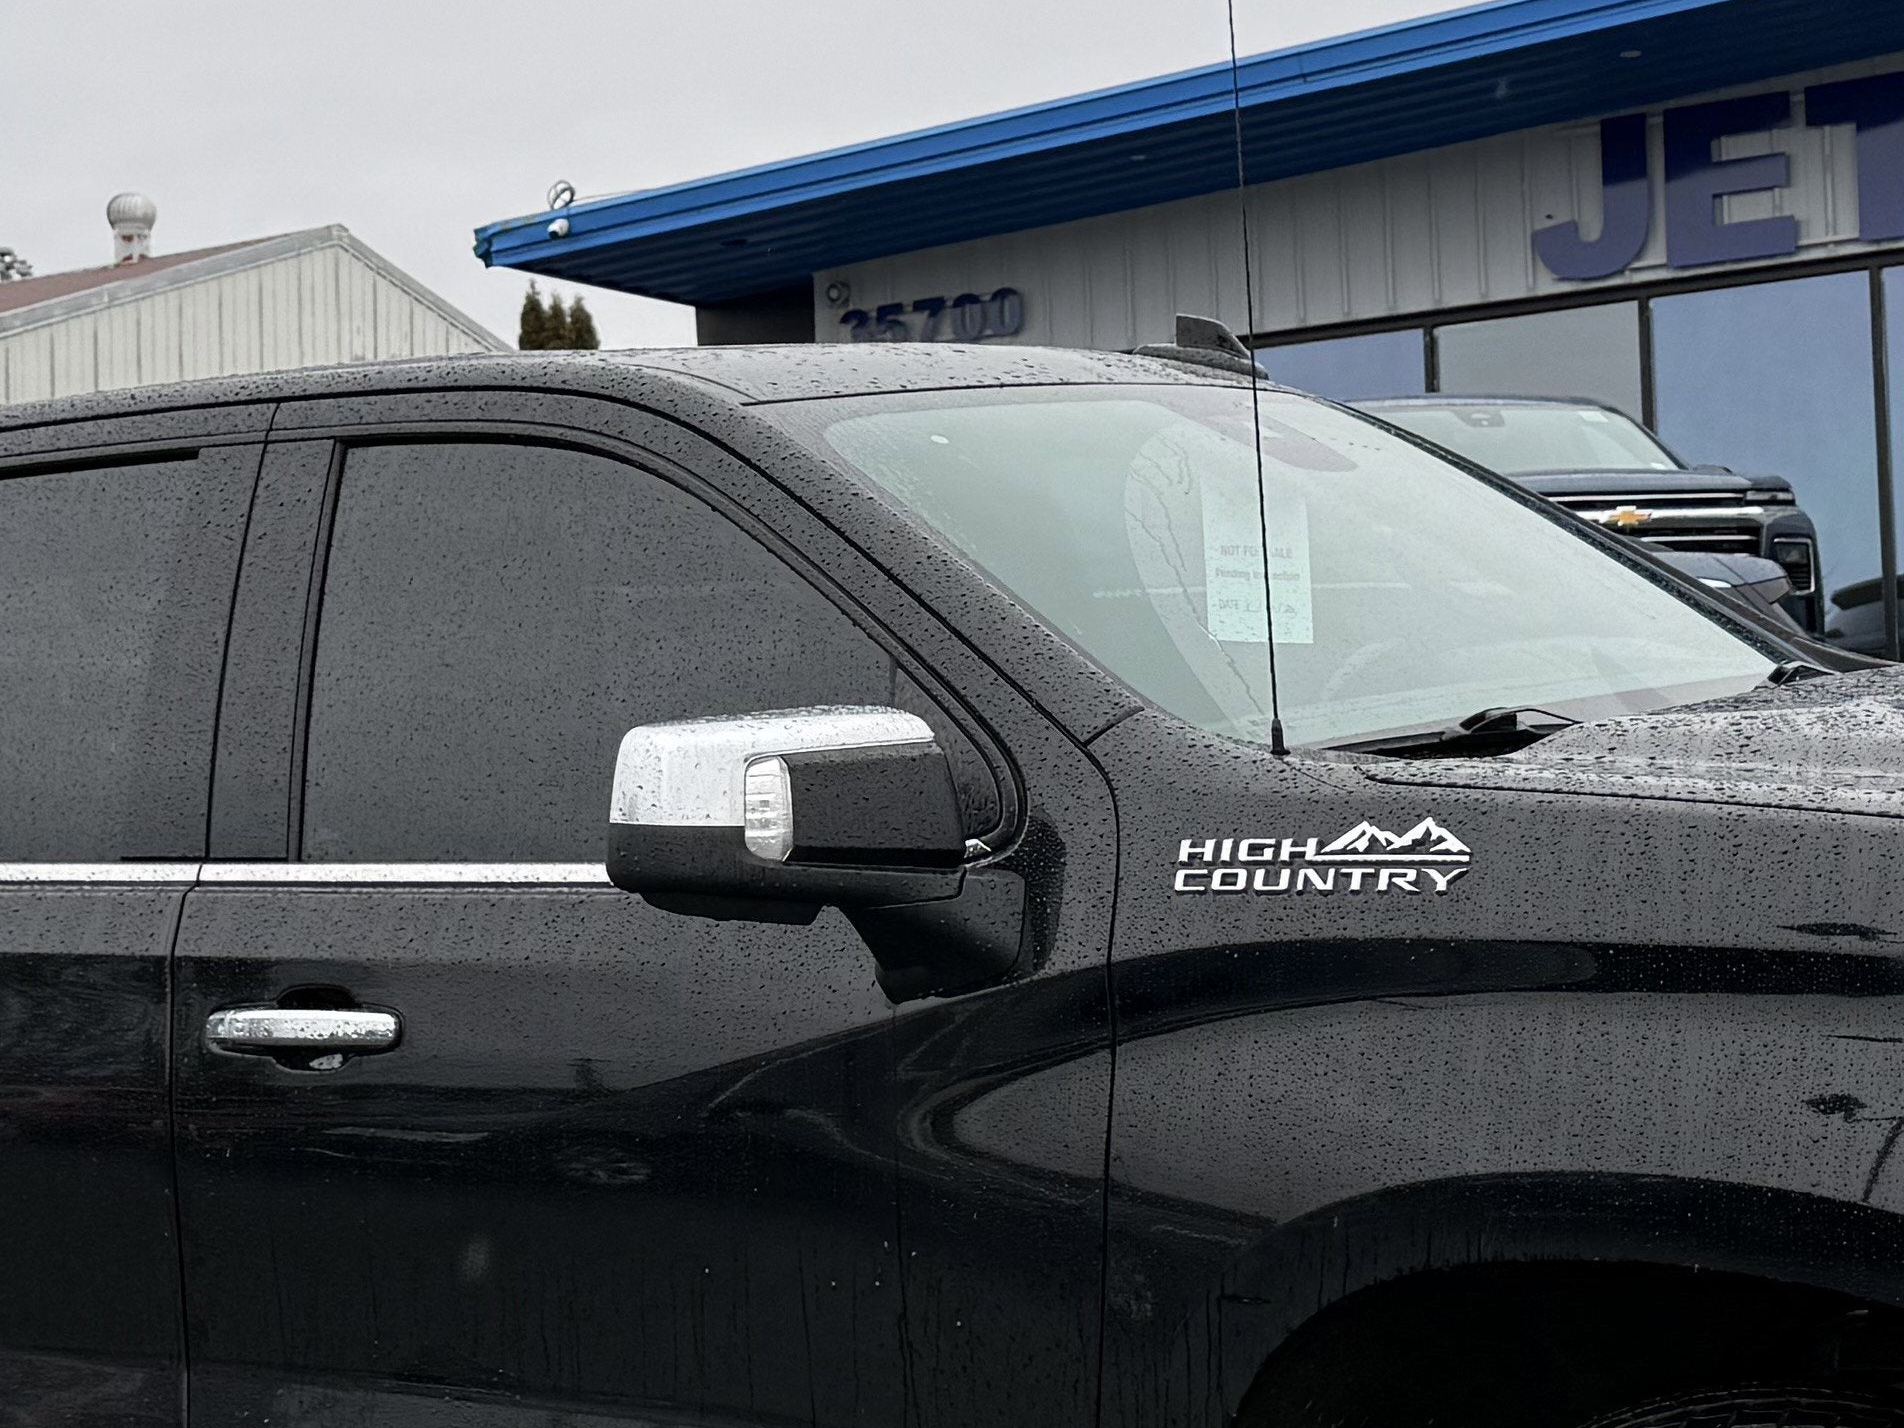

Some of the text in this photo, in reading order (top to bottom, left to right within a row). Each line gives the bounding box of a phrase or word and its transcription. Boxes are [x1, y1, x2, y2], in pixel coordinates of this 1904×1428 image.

[839, 287, 1025, 341] 35700
[1177, 836, 1321, 862] HIGH
[1174, 867, 1470, 893] COUNTRY
